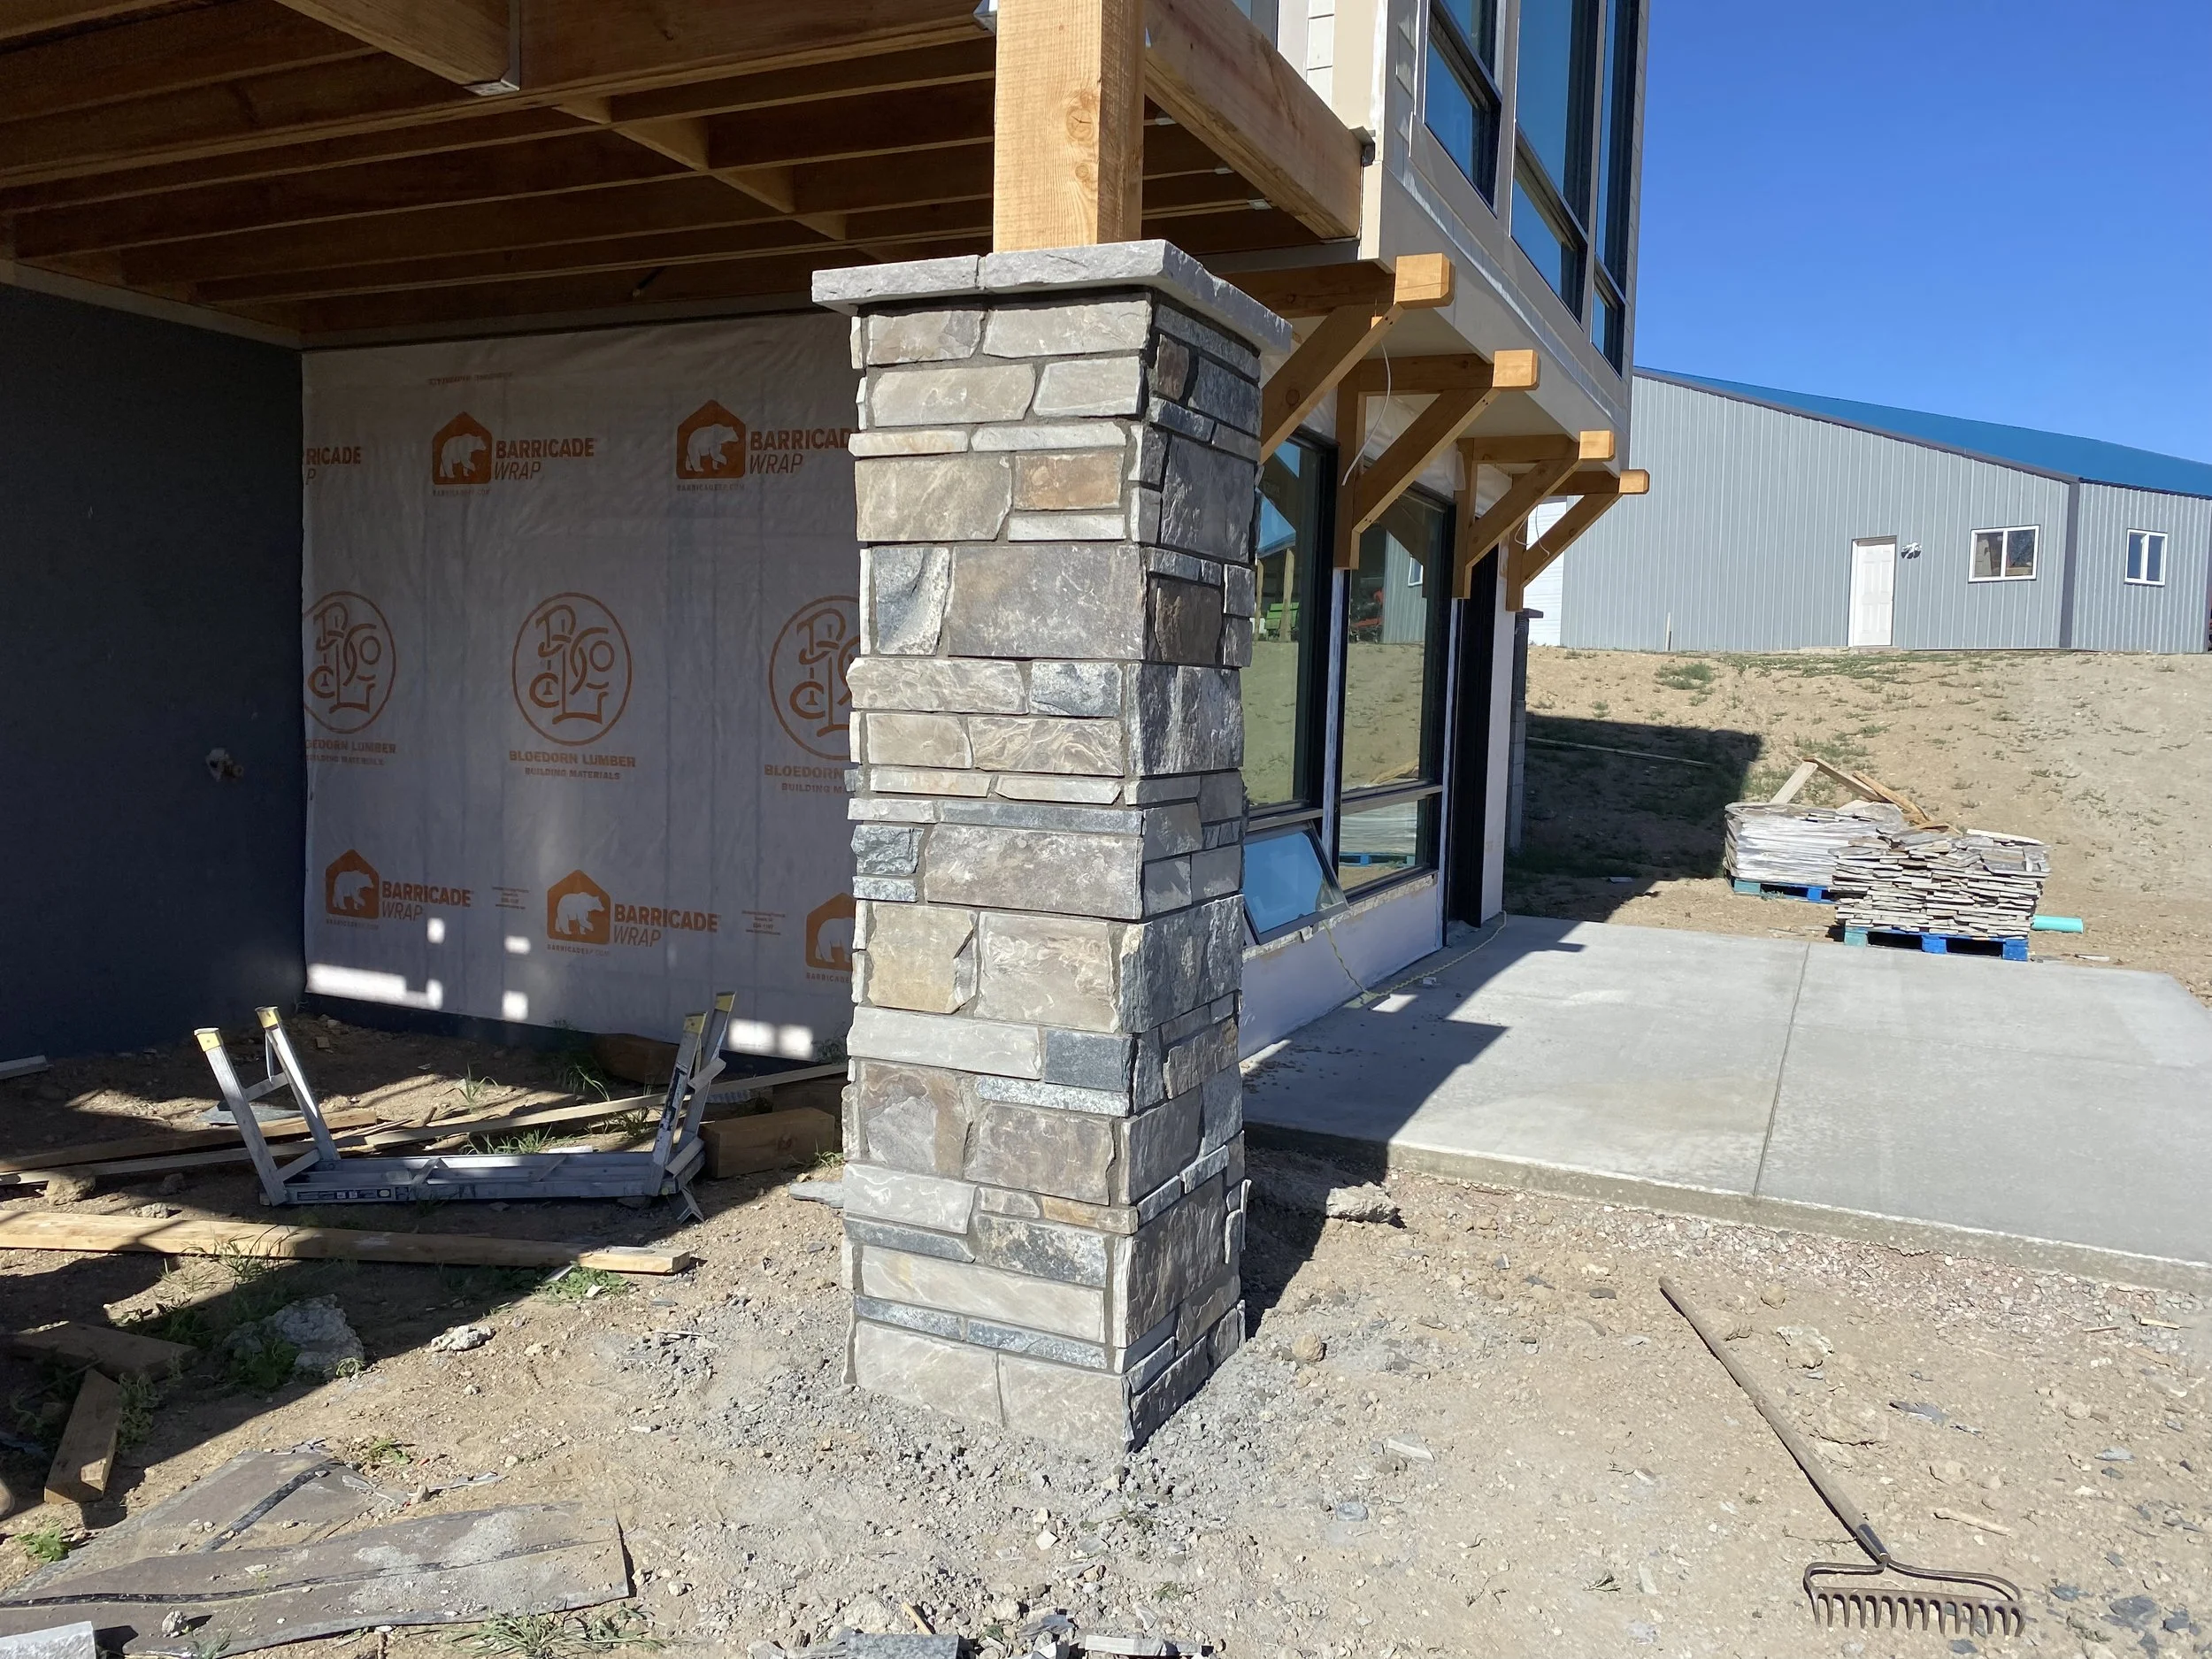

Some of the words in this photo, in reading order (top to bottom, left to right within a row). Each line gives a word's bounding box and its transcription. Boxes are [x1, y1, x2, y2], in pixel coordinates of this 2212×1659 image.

[495, 437, 595, 459] BARRICADE
[750, 427, 856, 451] BARRICAD
[495, 461, 541, 481] WRAP
[749, 453, 803, 475] WRAP
[351, 741, 396, 754] LUMBER
[510, 750, 578, 764] BLOEDORN
[582, 754, 636, 768] LUMBER
[525, 767, 567, 777] BUILDING
[569, 770, 621, 780] MATERIALS
[764, 764, 843, 780] BLOEDORN
[781, 782, 831, 794] BUILDING
[381, 880, 472, 908] BARRICADE
[381, 901, 423, 921] WRAP
[614, 903, 718, 933] BARRICADE
[613, 925, 661, 948] WRAP
[806, 972, 850, 984] BARRICADE
